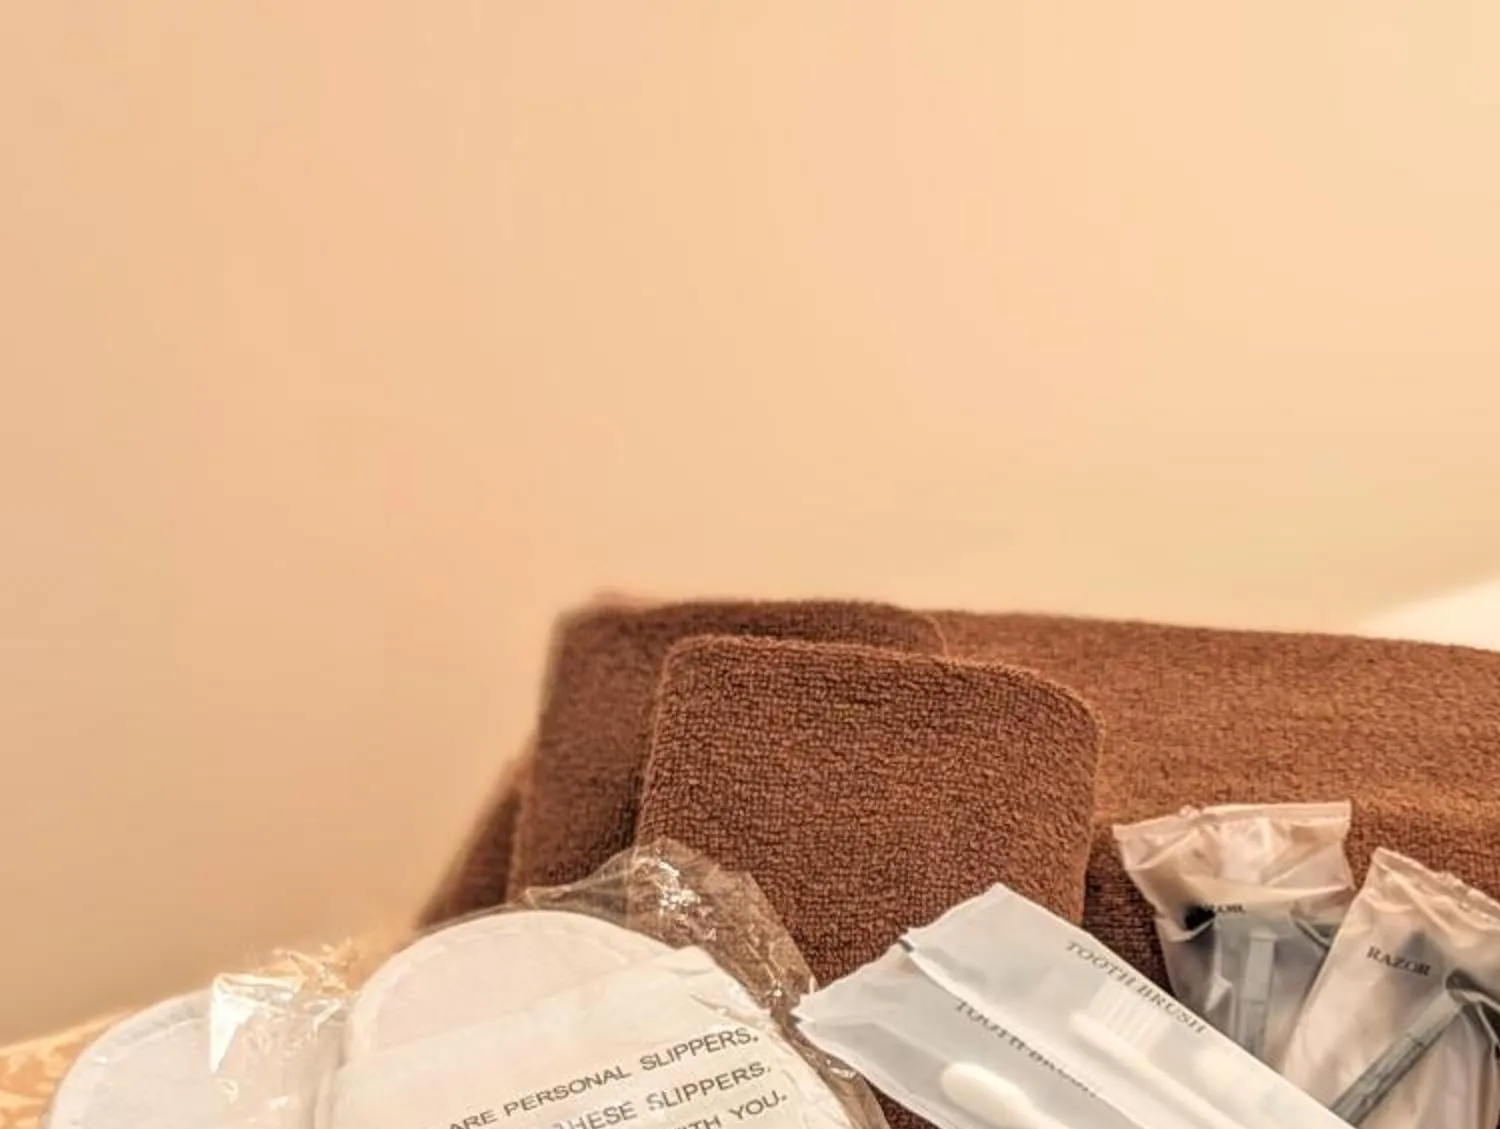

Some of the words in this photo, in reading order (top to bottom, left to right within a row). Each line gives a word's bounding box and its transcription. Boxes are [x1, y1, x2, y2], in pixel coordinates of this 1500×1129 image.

[1366, 946, 1432, 976] RAZOR
[503, 1065, 632, 1117] PERSONAL
[639, 1027, 759, 1072] SLIPPERS.
[645, 1060, 772, 1112] SLIPPERS.
[728, 1089, 788, 1121] YOU.
